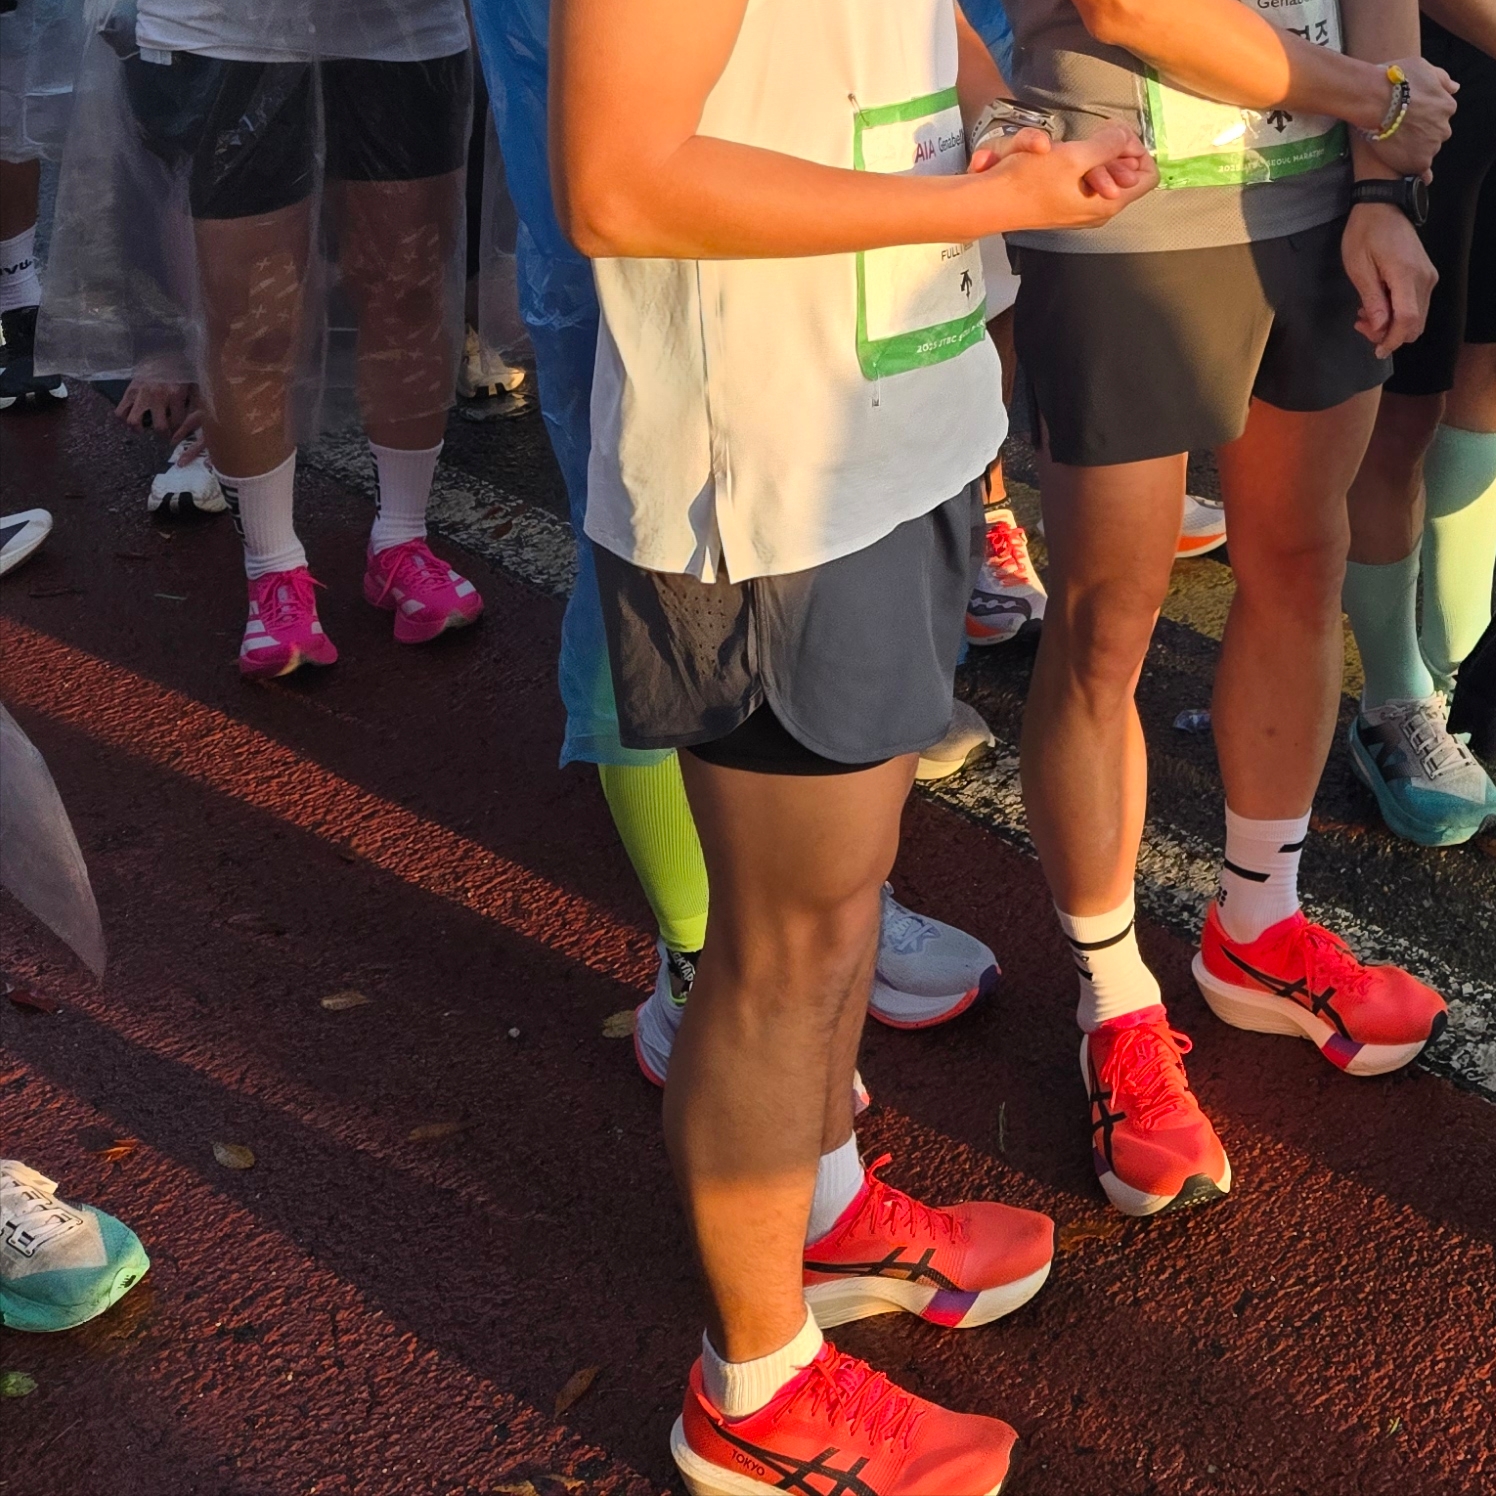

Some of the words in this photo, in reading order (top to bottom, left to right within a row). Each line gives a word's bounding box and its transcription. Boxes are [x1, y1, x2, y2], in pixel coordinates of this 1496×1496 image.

[915, 139, 937, 164] AIA
[941, 245, 960, 261] FULL
[731, 1448, 766, 1476] TOKYO
